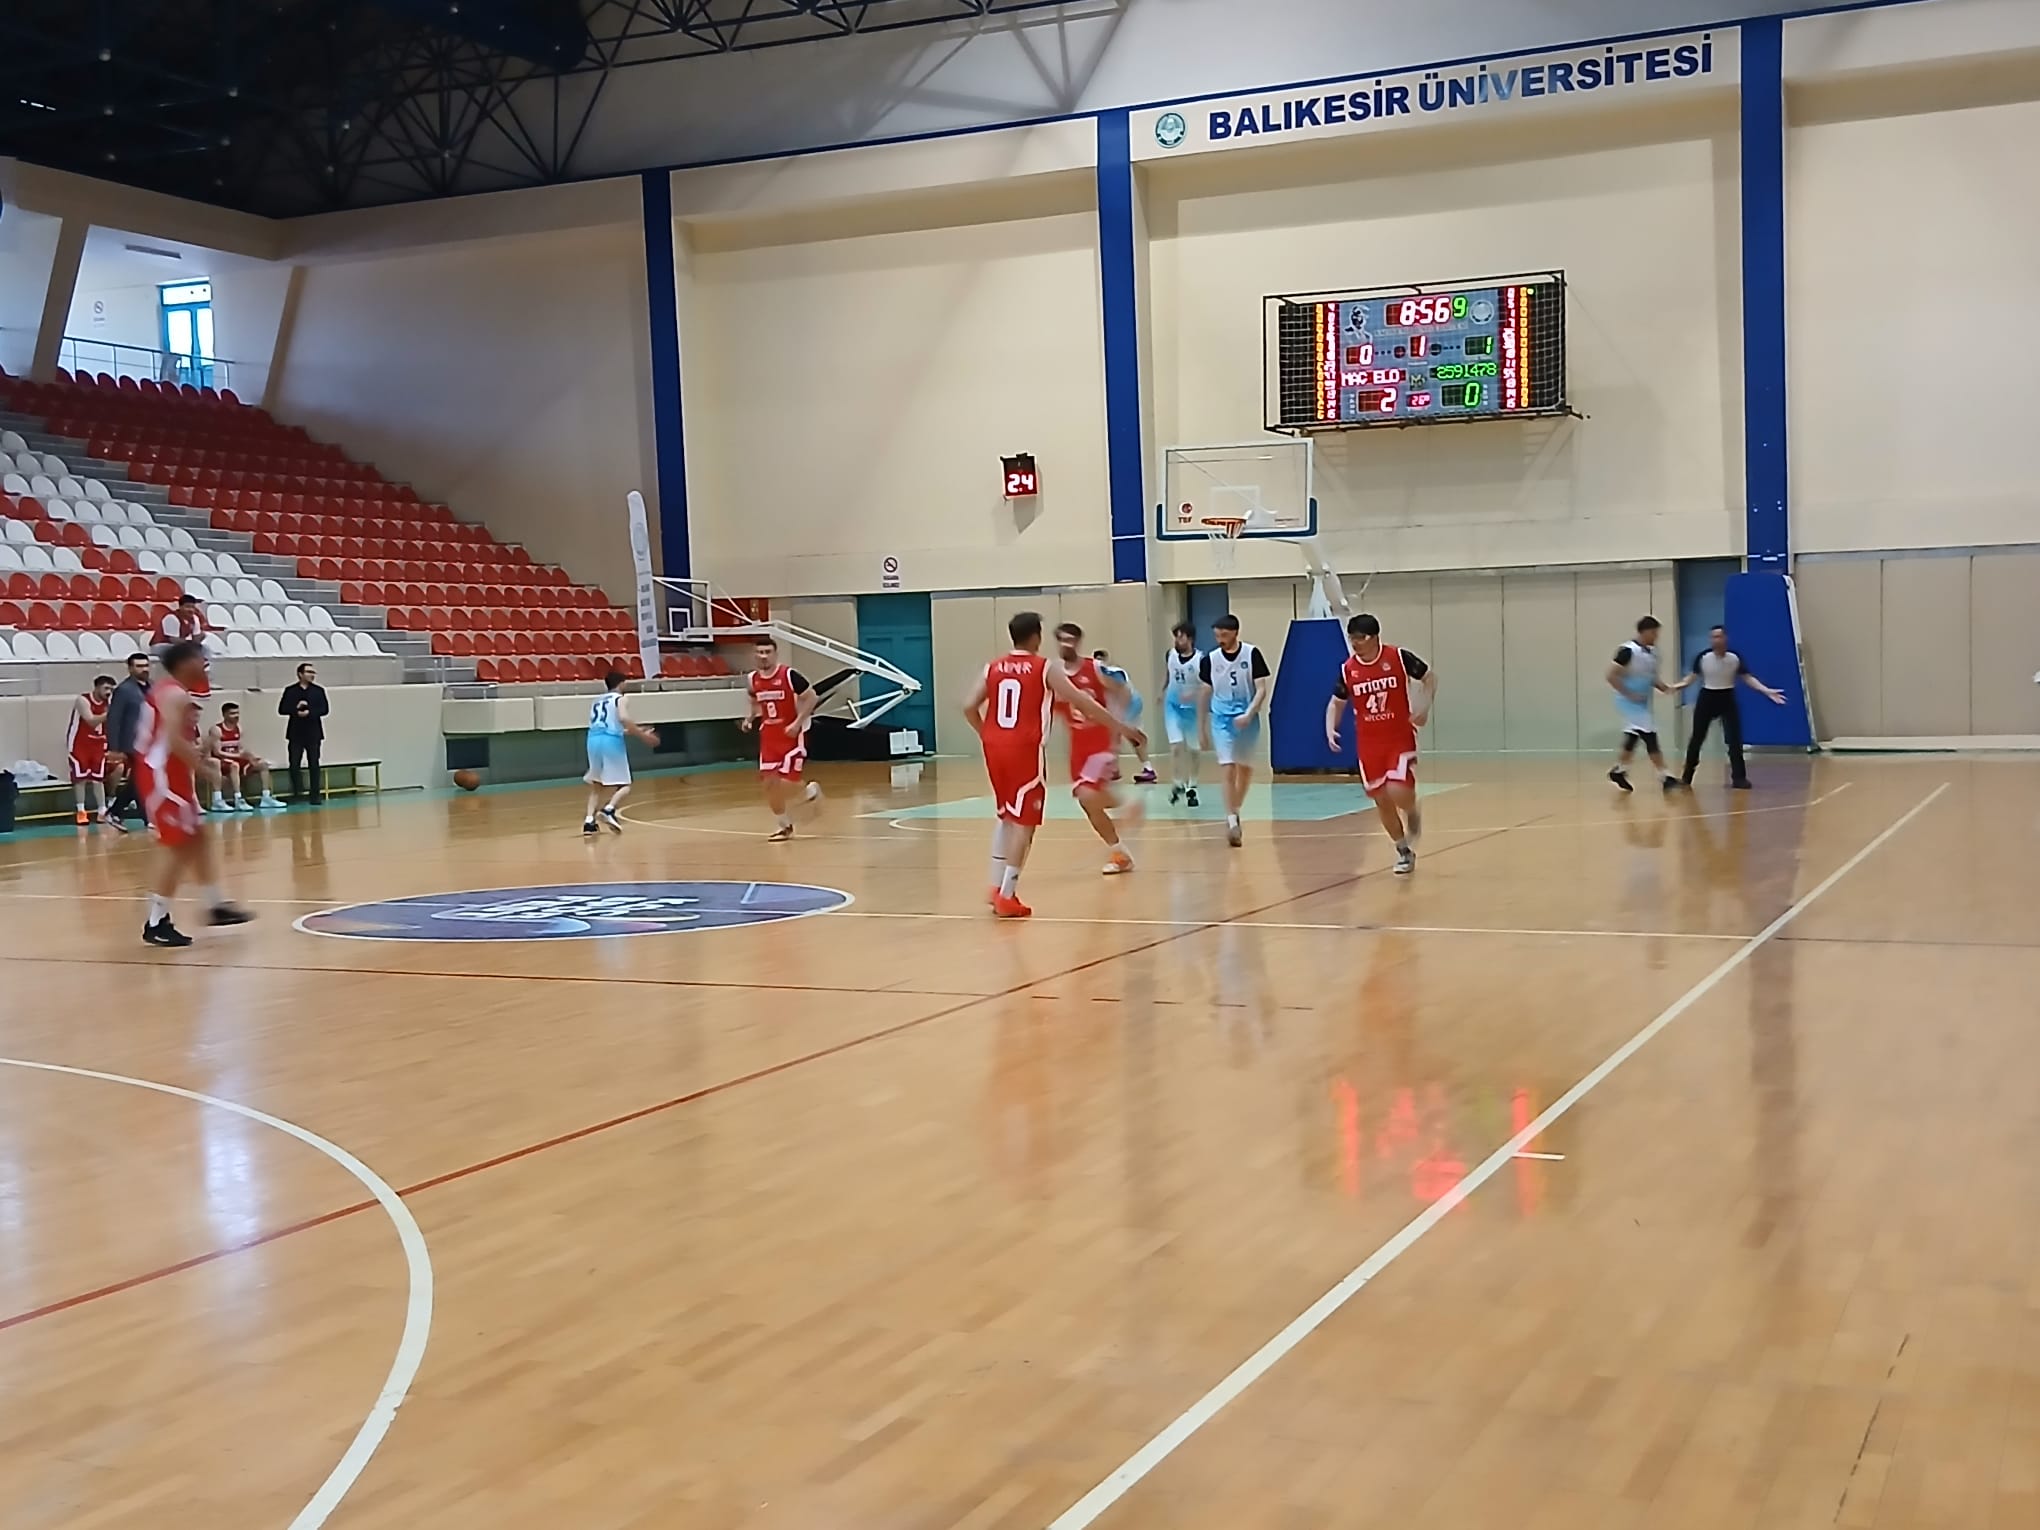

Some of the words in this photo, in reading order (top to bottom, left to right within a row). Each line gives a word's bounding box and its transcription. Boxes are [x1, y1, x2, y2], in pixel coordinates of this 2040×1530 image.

[1209, 79, 1411, 140] BALIKESİR
[1418, 33, 1713, 111] ÜNİVERSİTESİ
[1400, 297, 1450, 326] 8:56
[1453, 297, 1466, 317] 9
[1359, 345, 1373, 365] 0
[1380, 388, 1397, 412] 2
[1464, 383, 1480, 406] 0
[1230, 671, 1238, 686] 5
[997, 678, 1021, 729] 0
[1366, 691, 1388, 714] 47
